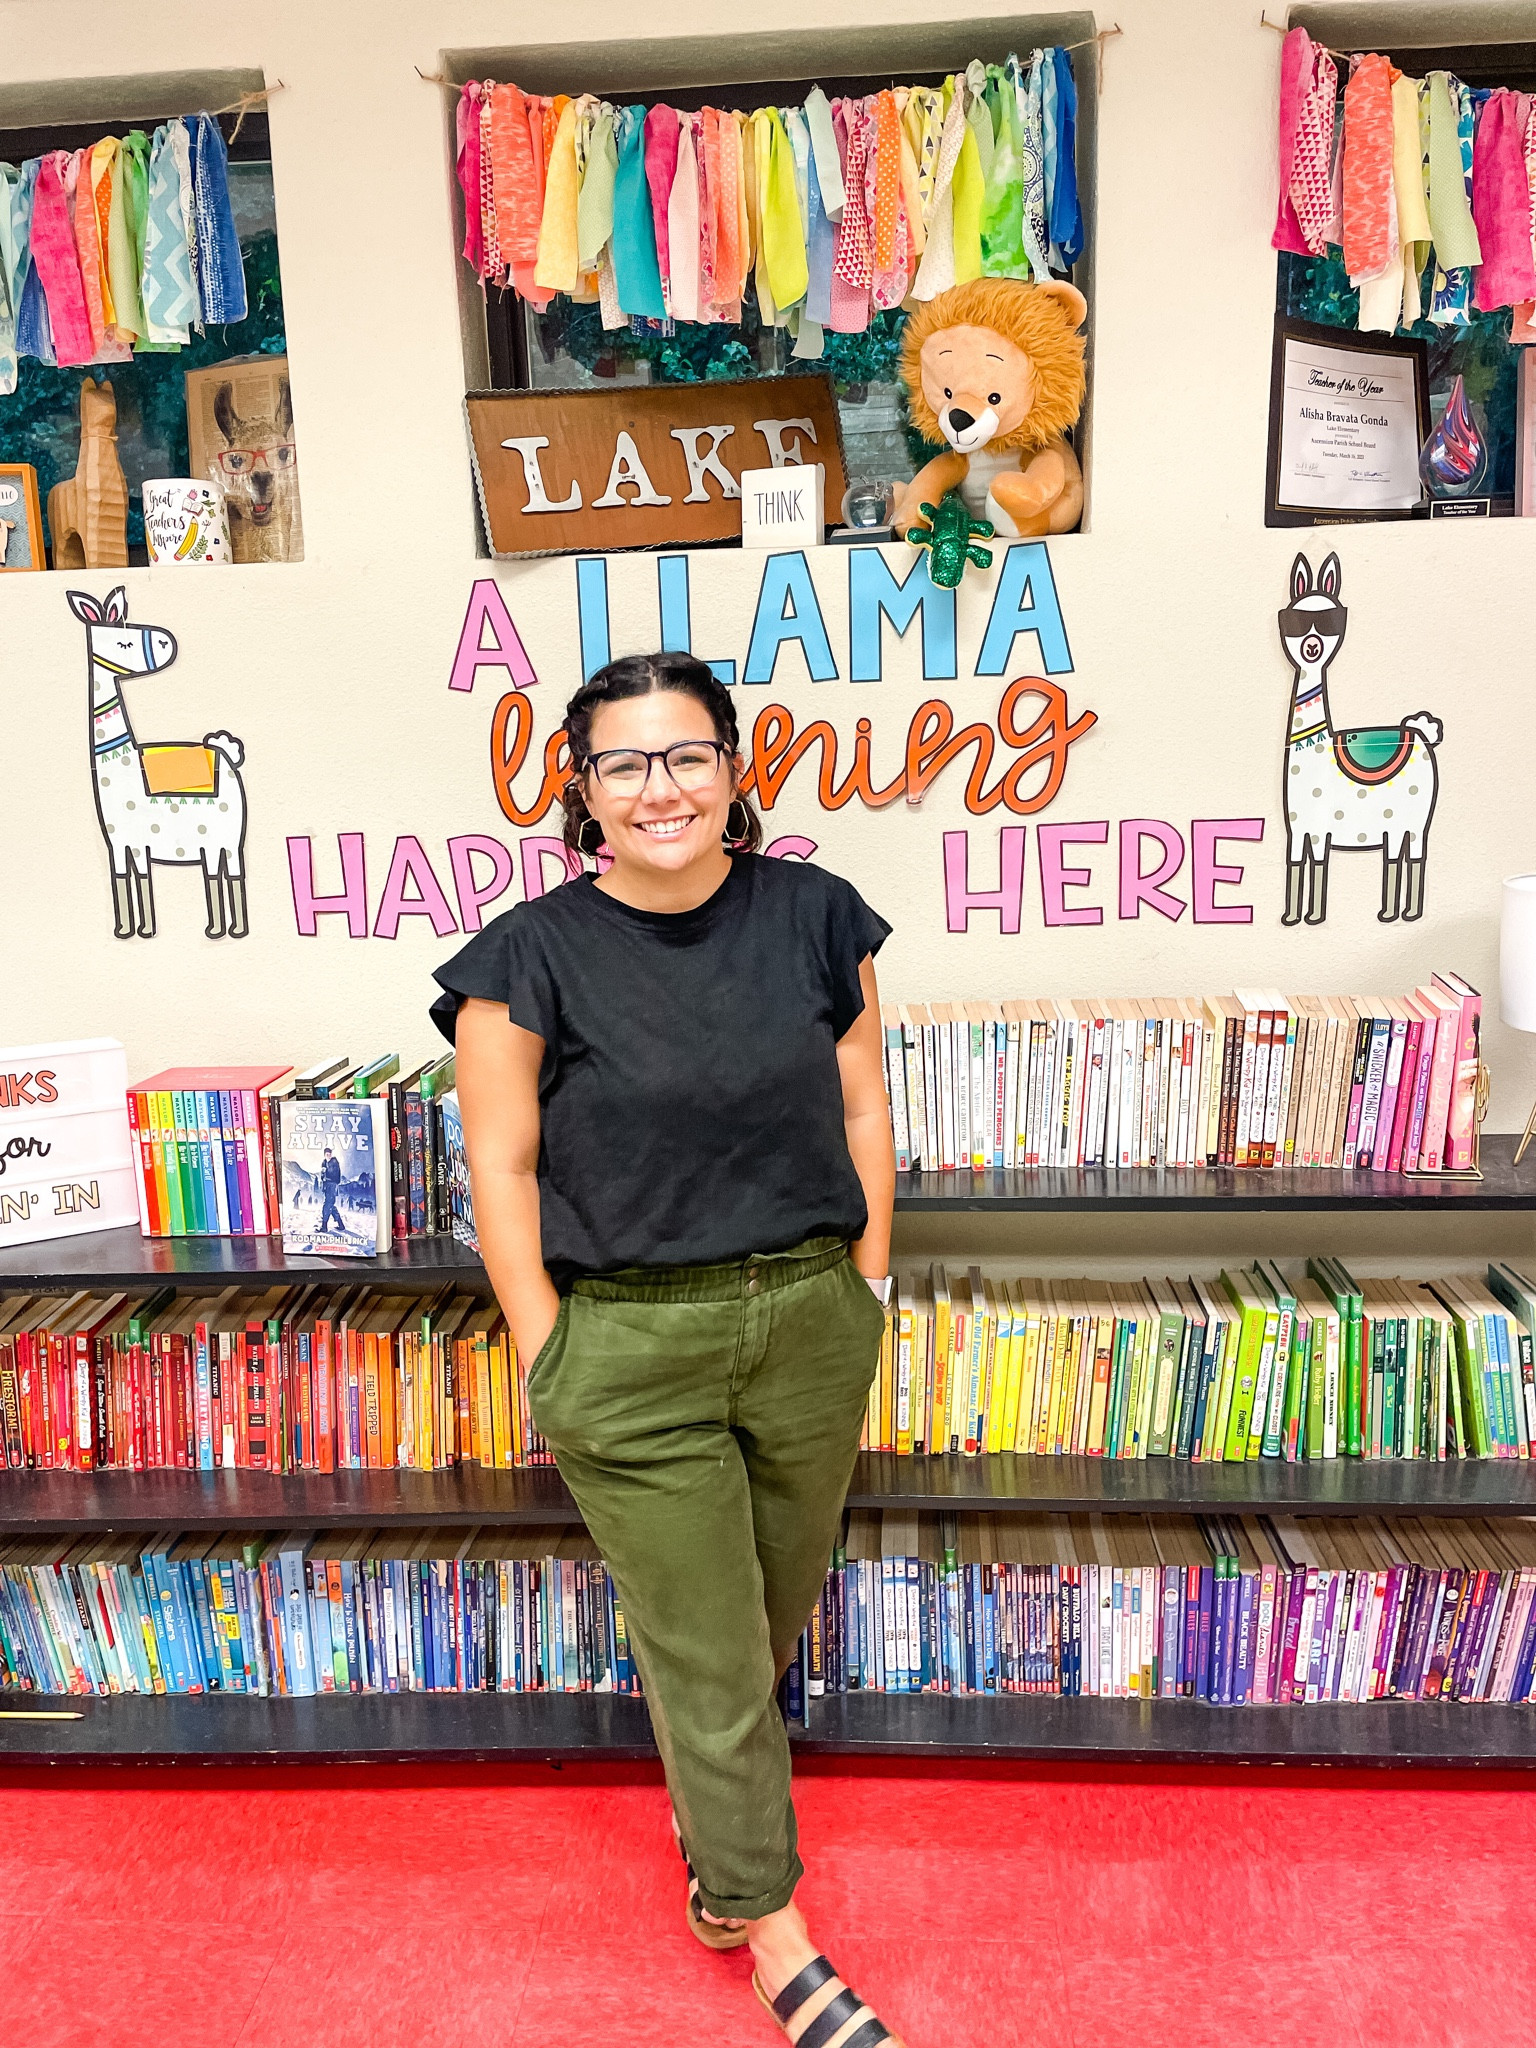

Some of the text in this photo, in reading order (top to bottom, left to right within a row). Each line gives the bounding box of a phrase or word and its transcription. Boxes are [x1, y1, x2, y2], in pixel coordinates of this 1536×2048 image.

[1308, 369, 1336, 388] Teacher
[1344, 380, 1356, 392] the
[1358, 377, 1384, 397] Year
[1299, 407, 1389, 427] Alisha Bravata Gonda
[1337, 426, 1360, 434] Elementary
[753, 488, 805, 526] THINK
[448, 539, 1074, 693] A LLAMA
[941, 817, 1266, 934] HERE
[1065, 1055, 1073, 1072] The
[1243, 1057, 1252, 1077] Wimpy
[1369, 1048, 1385, 1083] SNICKER
[1063, 1073, 1073, 1099] Magic
[1243, 1077, 1251, 1088] Kid
[1364, 1091, 1379, 1121] MAGIC
[294, 1115, 362, 1133] STAY
[287, 1132, 369, 1151] ALIVE
[437, 1162, 446, 1186] GIVER
[52, 1181, 100, 1215] IN
[291, 1235, 327, 1244] RODMAN
[1521, 1340, 1533, 1364] Wallace
[199, 1371, 206, 1385] ME
[318, 1342, 328, 1434] THE TRADING GAME
[480, 1371, 489, 1403] Becoming
[968, 1311, 983, 1437] The Old Farmer's Almanac for Kids
[1313, 1367, 1322, 1384] Ruby
[1, 1370, 17, 1430] FIRESTORM!
[366, 1375, 378, 1436] FIELD TRIPPED
[1313, 1386, 1321, 1406] Holler
[199, 1388, 209, 1450] EVERYTHING
[481, 1405, 489, 1425] Naomi
[1236, 1410, 1247, 1438] FUNNIEST
[76, 1598, 88, 1627] TITANIC
[198, 1600, 209, 1627] PHANTOM
[1072, 1588, 1080, 1622] BUFFALO
[1262, 1603, 1272, 1625] DORK
[163, 1605, 176, 1641] Sisters
[615, 1610, 625, 1639] LIBERTY
[1062, 1606, 1070, 1644] CROCKETT
[1187, 1610, 1195, 1631] HOLES
[1240, 1611, 1249, 1637] BLACK
[1285, 1617, 1299, 1650] Braced
[1310, 1593, 1325, 1666] QUINN ARF
[596, 1623, 604, 1655] LIGHTNING
[812, 1617, 820, 1672] BECAME GOLIATH
[976, 1645, 982, 1653] OF
[1101, 1626, 1110, 1645] STRAYS
[1102, 1646, 1110, 1656] LIKE
[1238, 1639, 1248, 1670] BEAUTY
